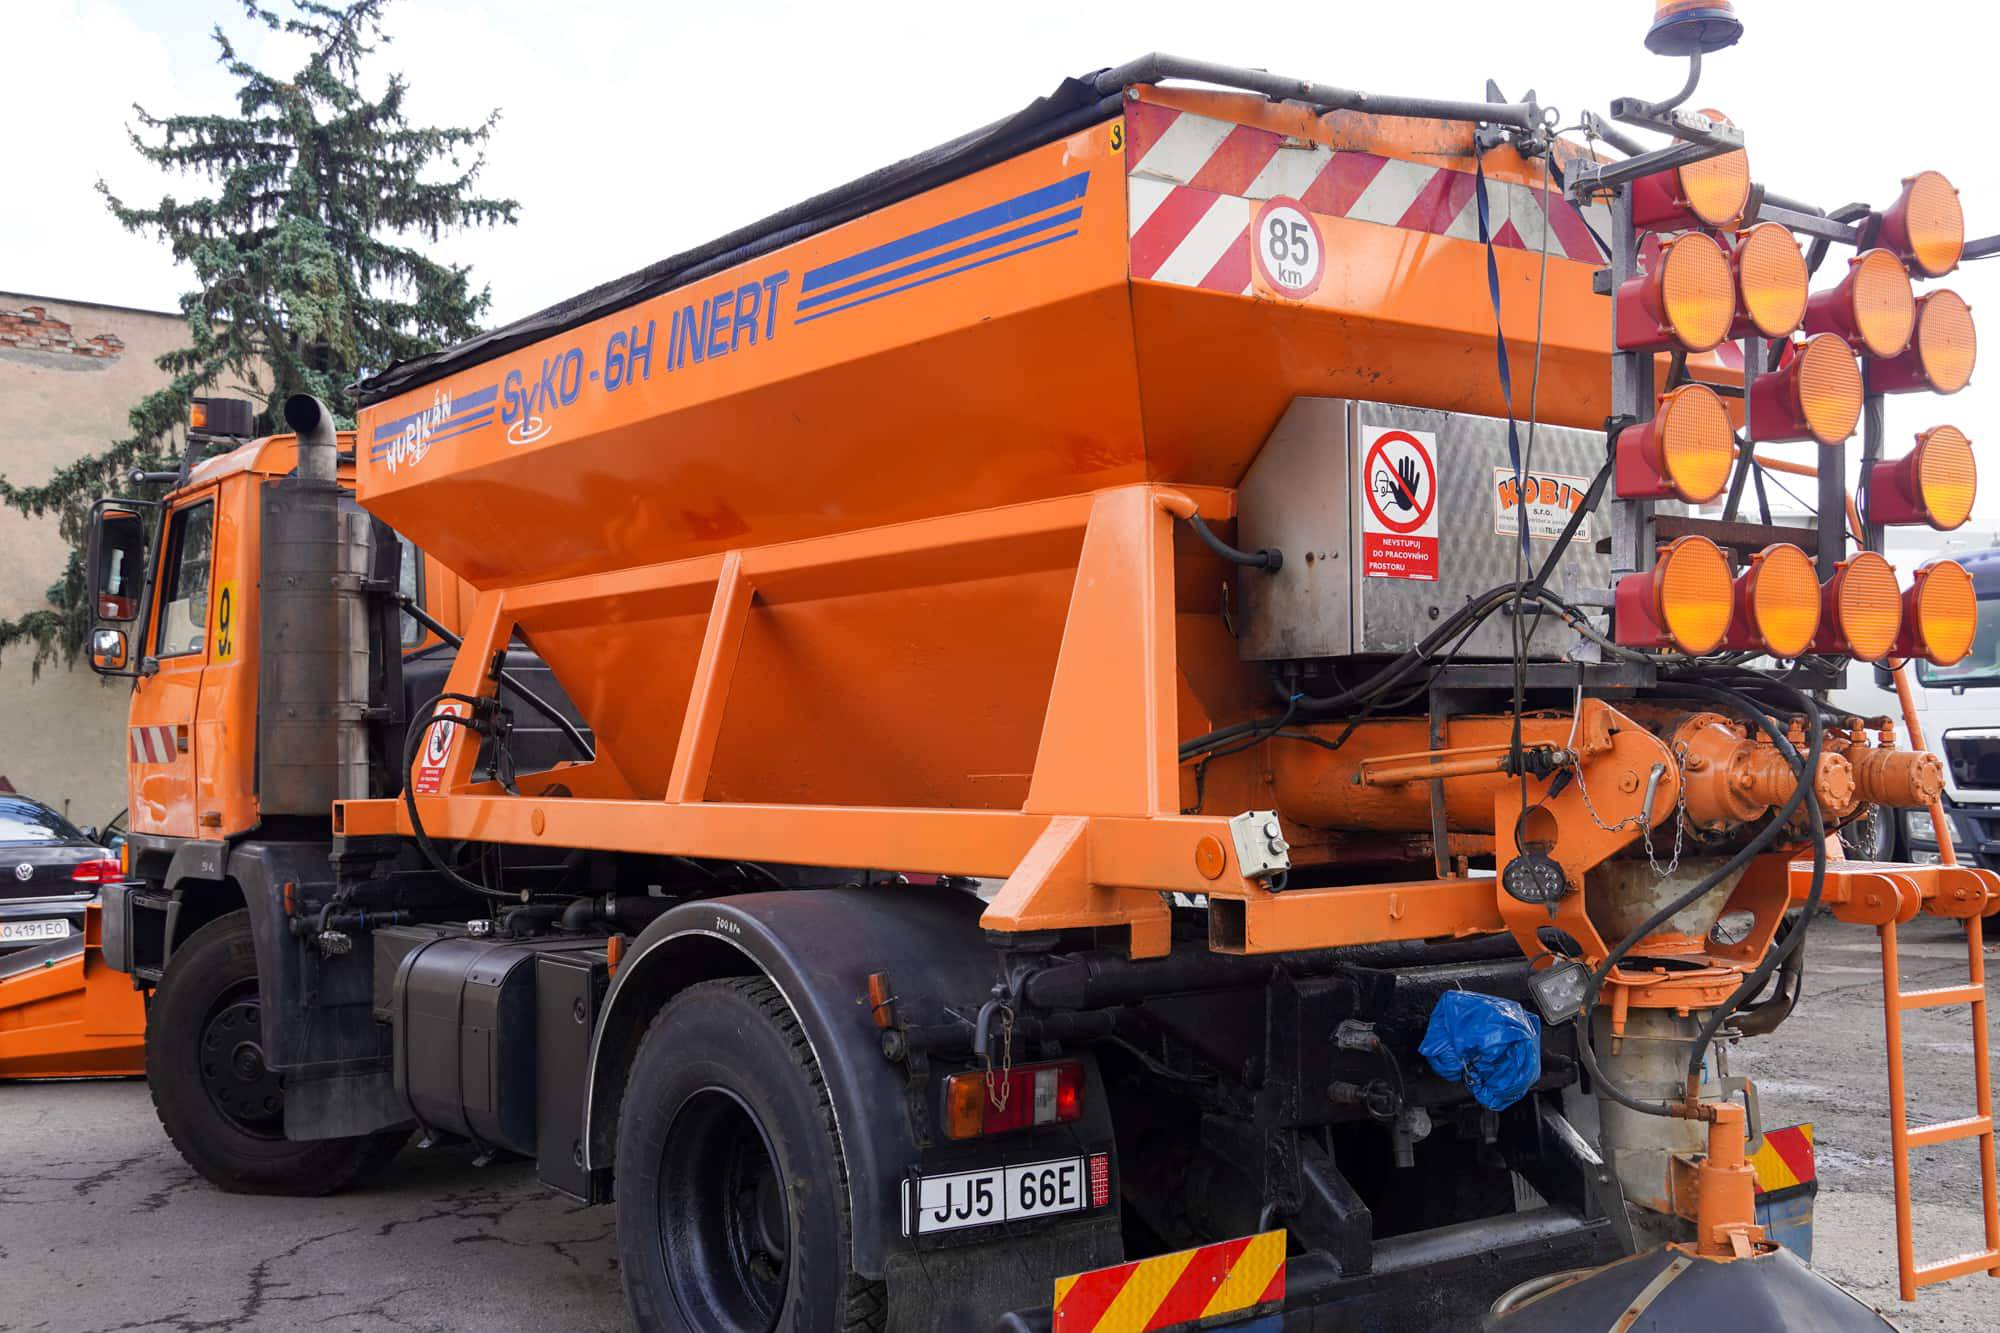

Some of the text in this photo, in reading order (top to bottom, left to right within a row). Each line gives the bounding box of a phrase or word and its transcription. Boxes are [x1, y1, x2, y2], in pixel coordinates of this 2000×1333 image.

[1269, 217, 1309, 266] 85
[1278, 262, 1303, 285] km
[666, 269, 790, 372] INERT
[1382, 538, 1421, 549] NEVSTUPUJ
[1368, 561, 1406, 571] PROSTORU
[1372, 550, 1430, 561] DO PRACOVNÍHO
[934, 1165, 1076, 1223] JJ5 66E
